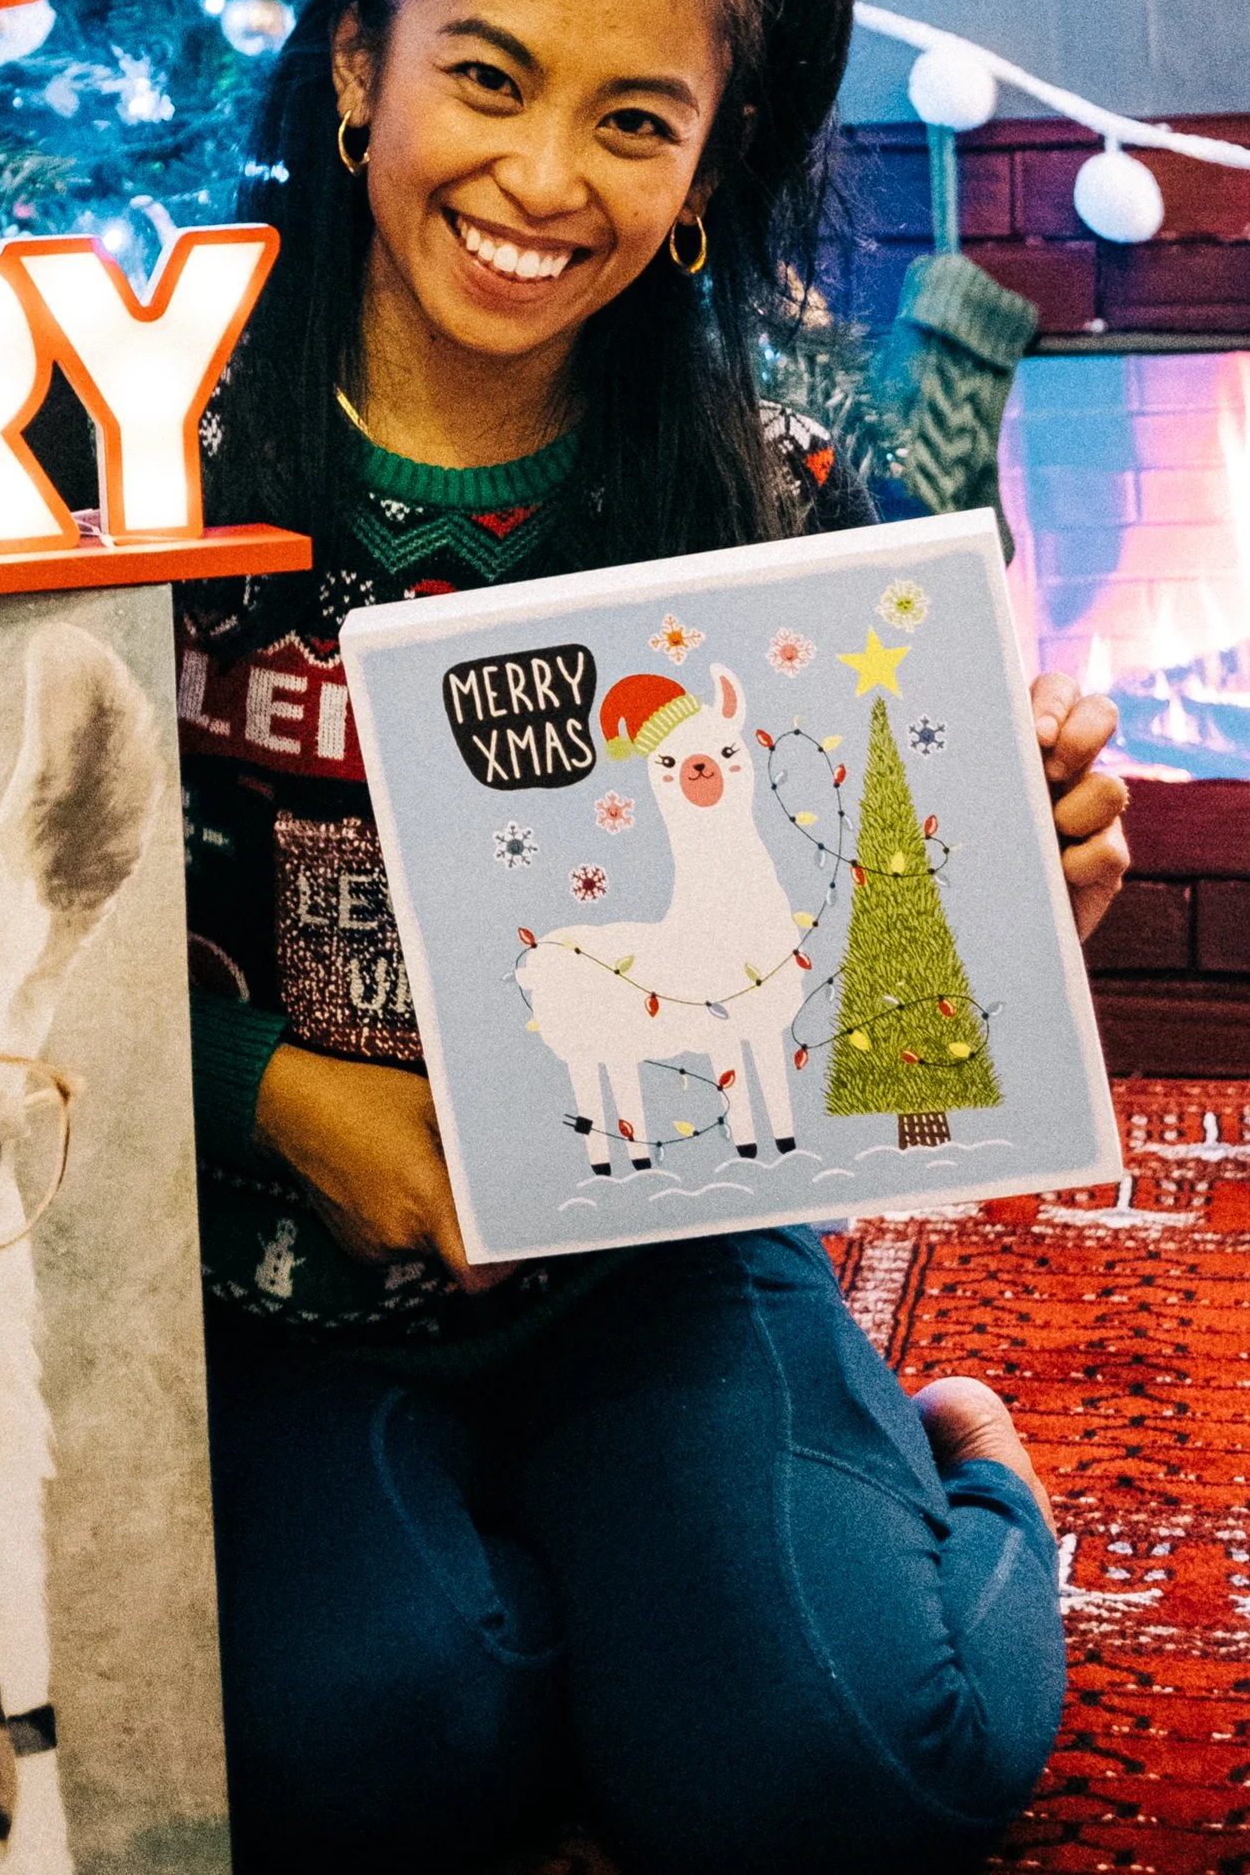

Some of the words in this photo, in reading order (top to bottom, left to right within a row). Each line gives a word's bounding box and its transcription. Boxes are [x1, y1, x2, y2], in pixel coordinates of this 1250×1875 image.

[449, 651, 585, 724] MERRY
[472, 717, 593, 783] XMAS
[297, 872, 395, 930] LE
